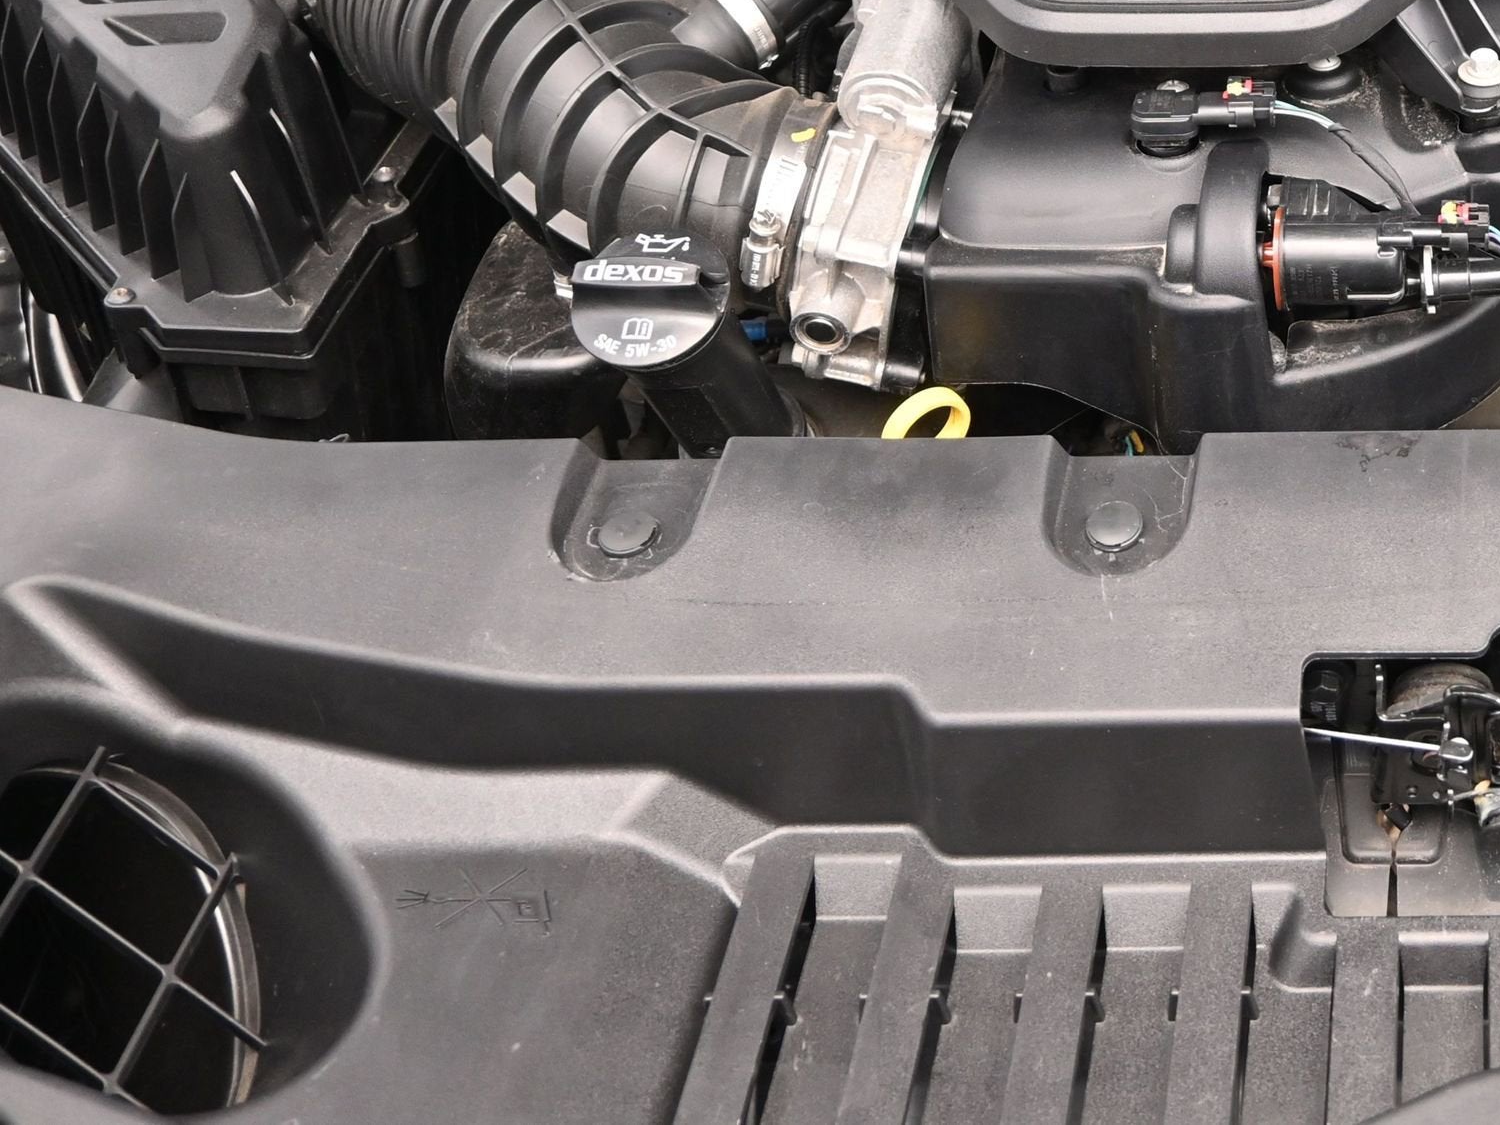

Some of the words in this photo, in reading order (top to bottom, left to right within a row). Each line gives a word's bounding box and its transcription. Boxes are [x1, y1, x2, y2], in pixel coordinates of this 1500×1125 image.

[583, 259, 689, 283] dexos
[594, 333, 621, 355] SAE
[625, 335, 677, 358] 5W-30
